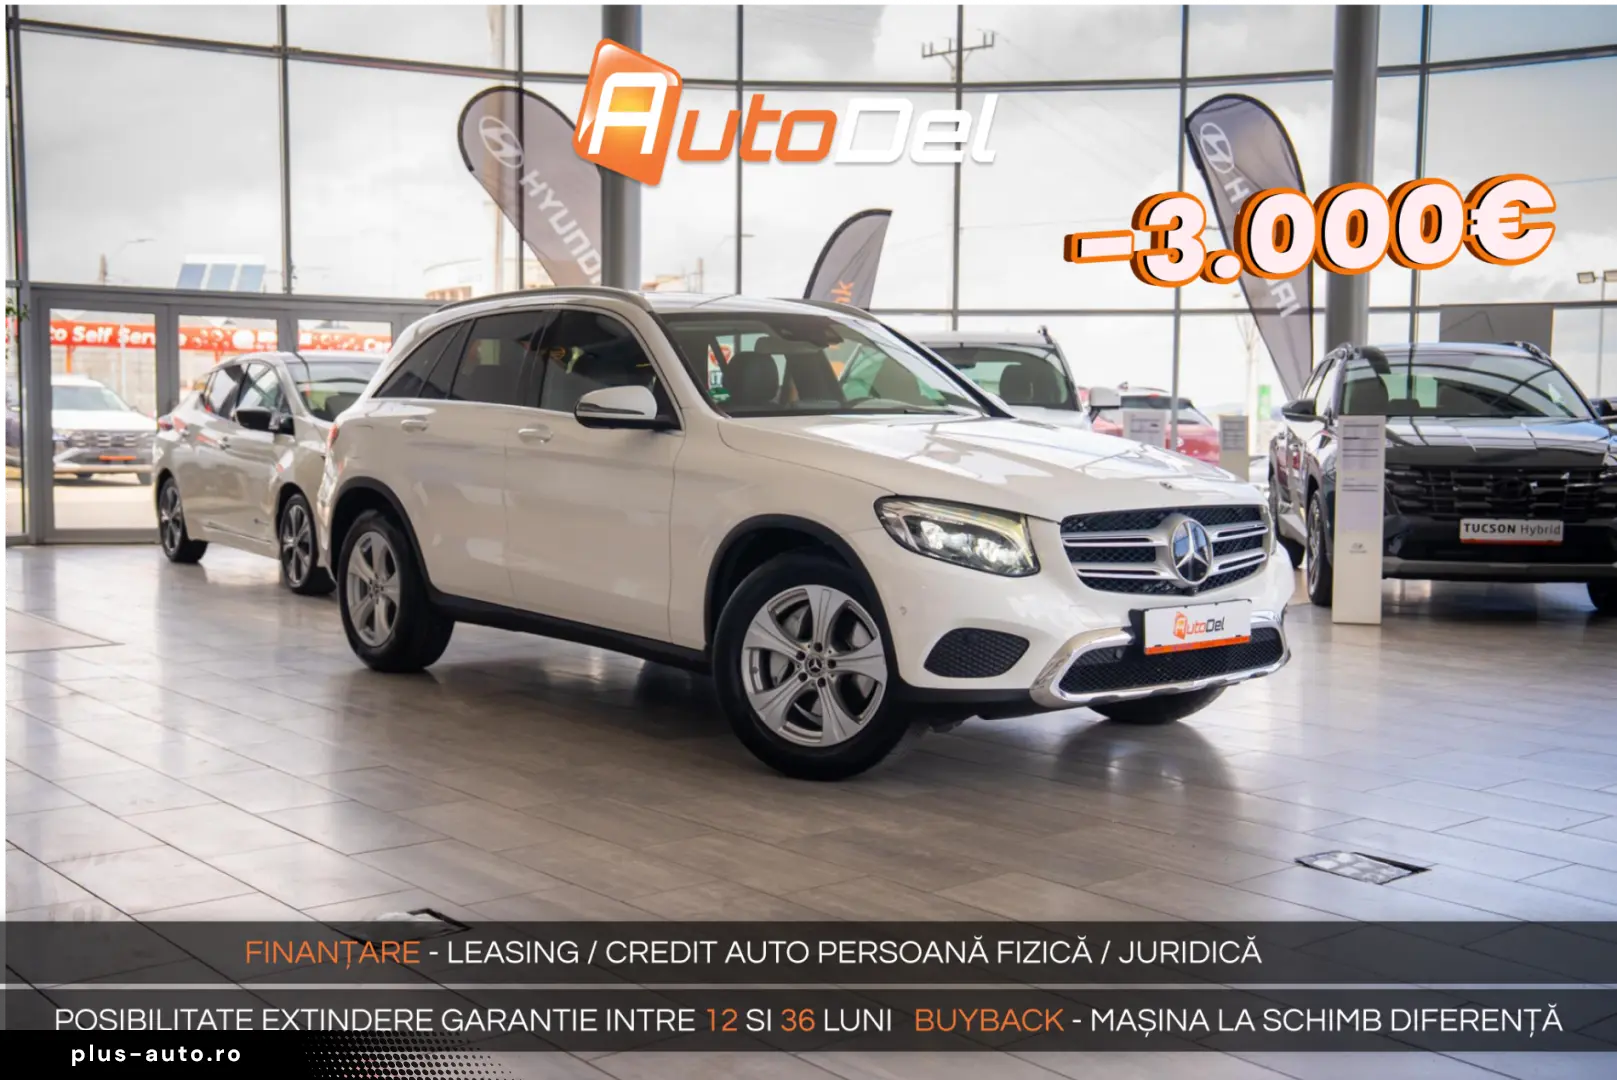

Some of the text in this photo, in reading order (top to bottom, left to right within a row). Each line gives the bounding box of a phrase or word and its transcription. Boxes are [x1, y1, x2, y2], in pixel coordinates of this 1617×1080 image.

[519, 169, 602, 285] HYUND
[72, 325, 113, 343] Self
[1463, 523, 1561, 537] TUCSON Hybrid
[1173, 614, 1226, 637] AutoDel
